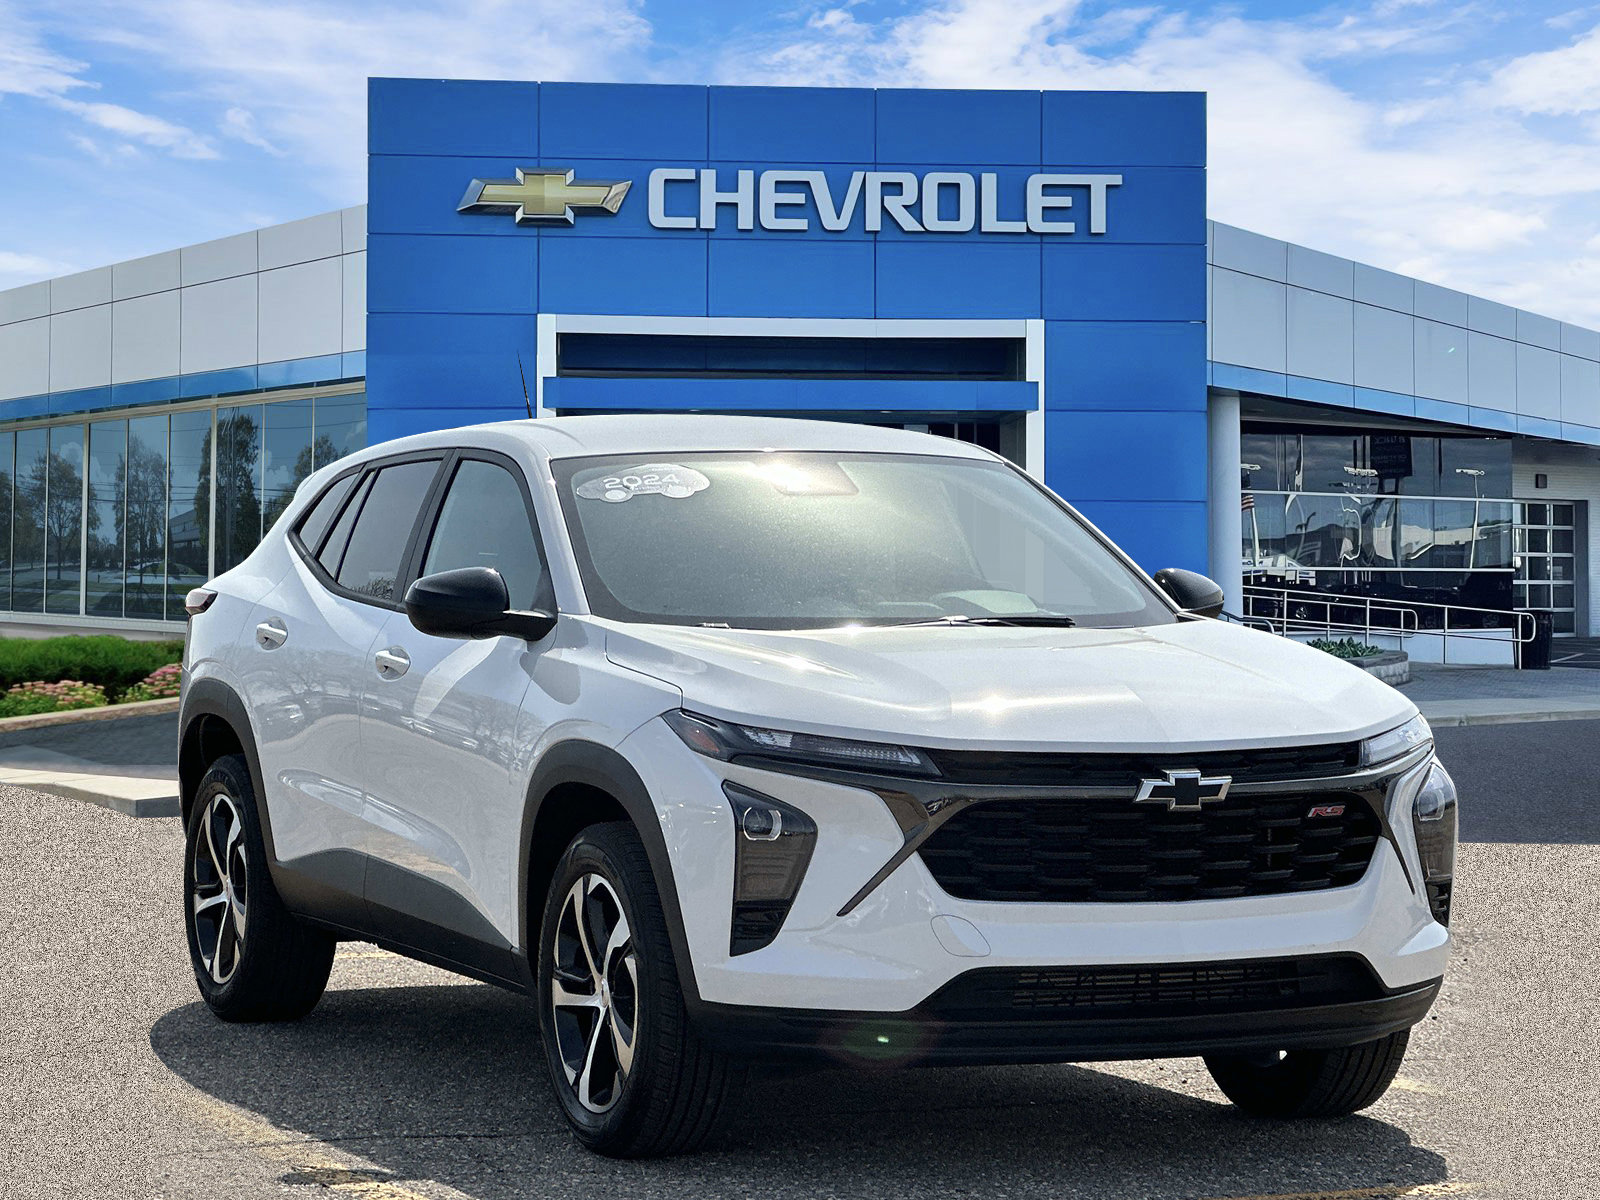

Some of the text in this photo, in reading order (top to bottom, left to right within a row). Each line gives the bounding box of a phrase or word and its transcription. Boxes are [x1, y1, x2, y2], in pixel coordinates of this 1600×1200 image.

[648, 168, 1123, 235] CHEVROLET
[603, 473, 680, 489] 2024
[1308, 805, 1345, 818] RS
